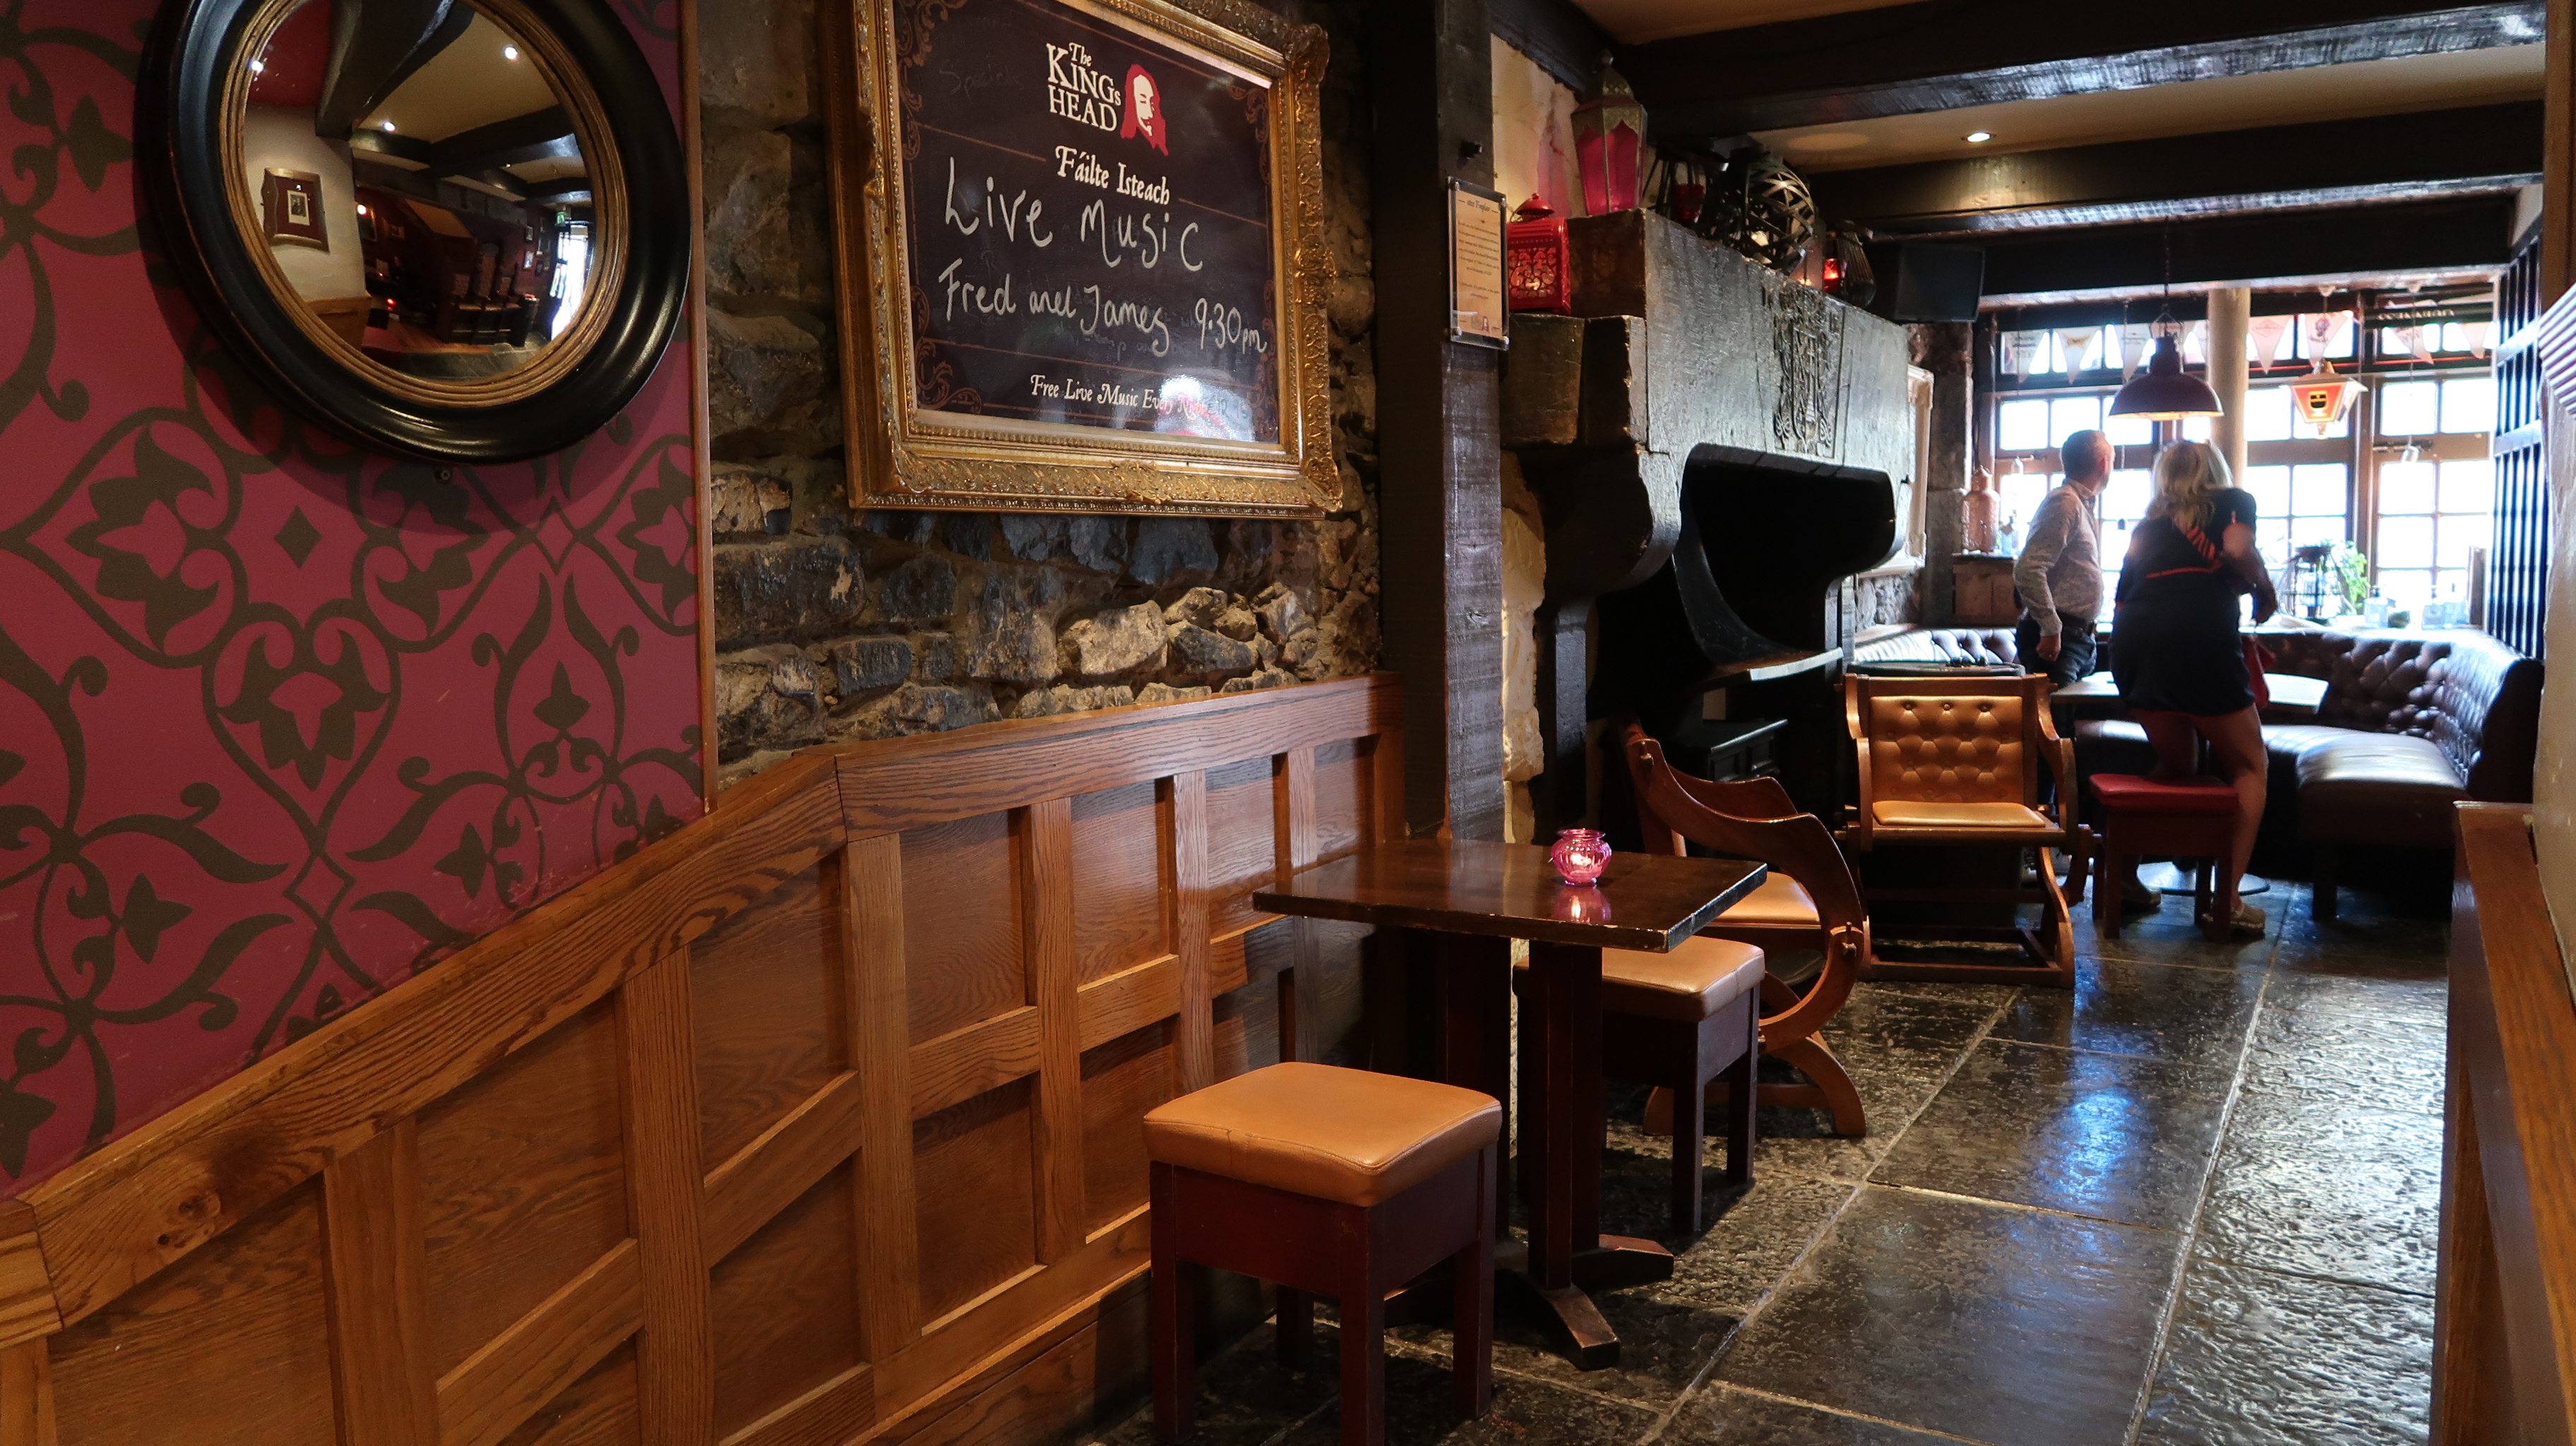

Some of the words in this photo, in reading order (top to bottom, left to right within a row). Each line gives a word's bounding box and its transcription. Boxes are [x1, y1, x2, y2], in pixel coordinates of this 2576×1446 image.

[1068, 42, 1092, 67] The
[1047, 83, 1118, 131] HEAD
[945, 156, 1054, 248] Live
[1055, 145, 1109, 189] Fáilte
[1116, 162, 1170, 205] Isteach
[938, 257, 1017, 322] Fred
[1029, 285, 1077, 318] and
[1080, 284, 1170, 357] James
[1030, 374, 1059, 398] Free
[1064, 378, 1093, 402] Live
[1097, 383, 1139, 406] Music
[1142, 389, 1174, 414] Every
